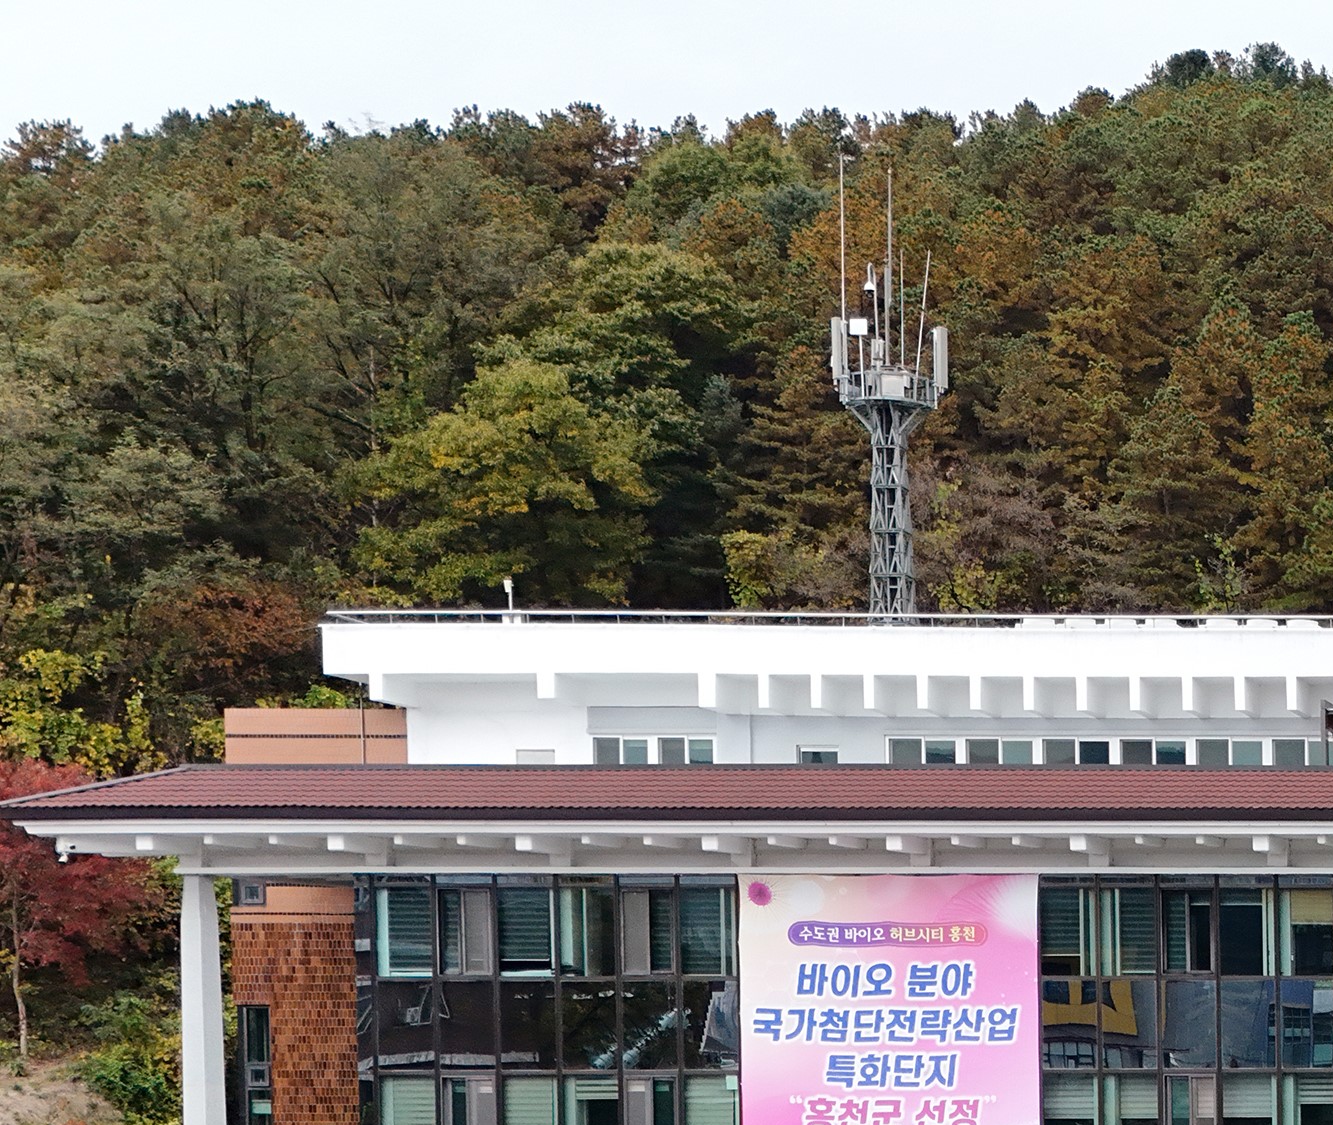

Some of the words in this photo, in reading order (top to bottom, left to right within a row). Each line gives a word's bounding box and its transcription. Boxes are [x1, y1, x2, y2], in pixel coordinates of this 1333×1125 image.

[799, 926, 839, 942] 수도권
[845, 927, 885, 942] 바이오
[890, 926, 943, 942] 허브시티
[949, 925, 976, 942] 홍천
[797, 963, 893, 998] 바이오
[907, 963, 973, 998] 분야
[752, 1007, 1018, 1044] 국가첨단전략산업
[825, 1053, 958, 1089] 특화단지
